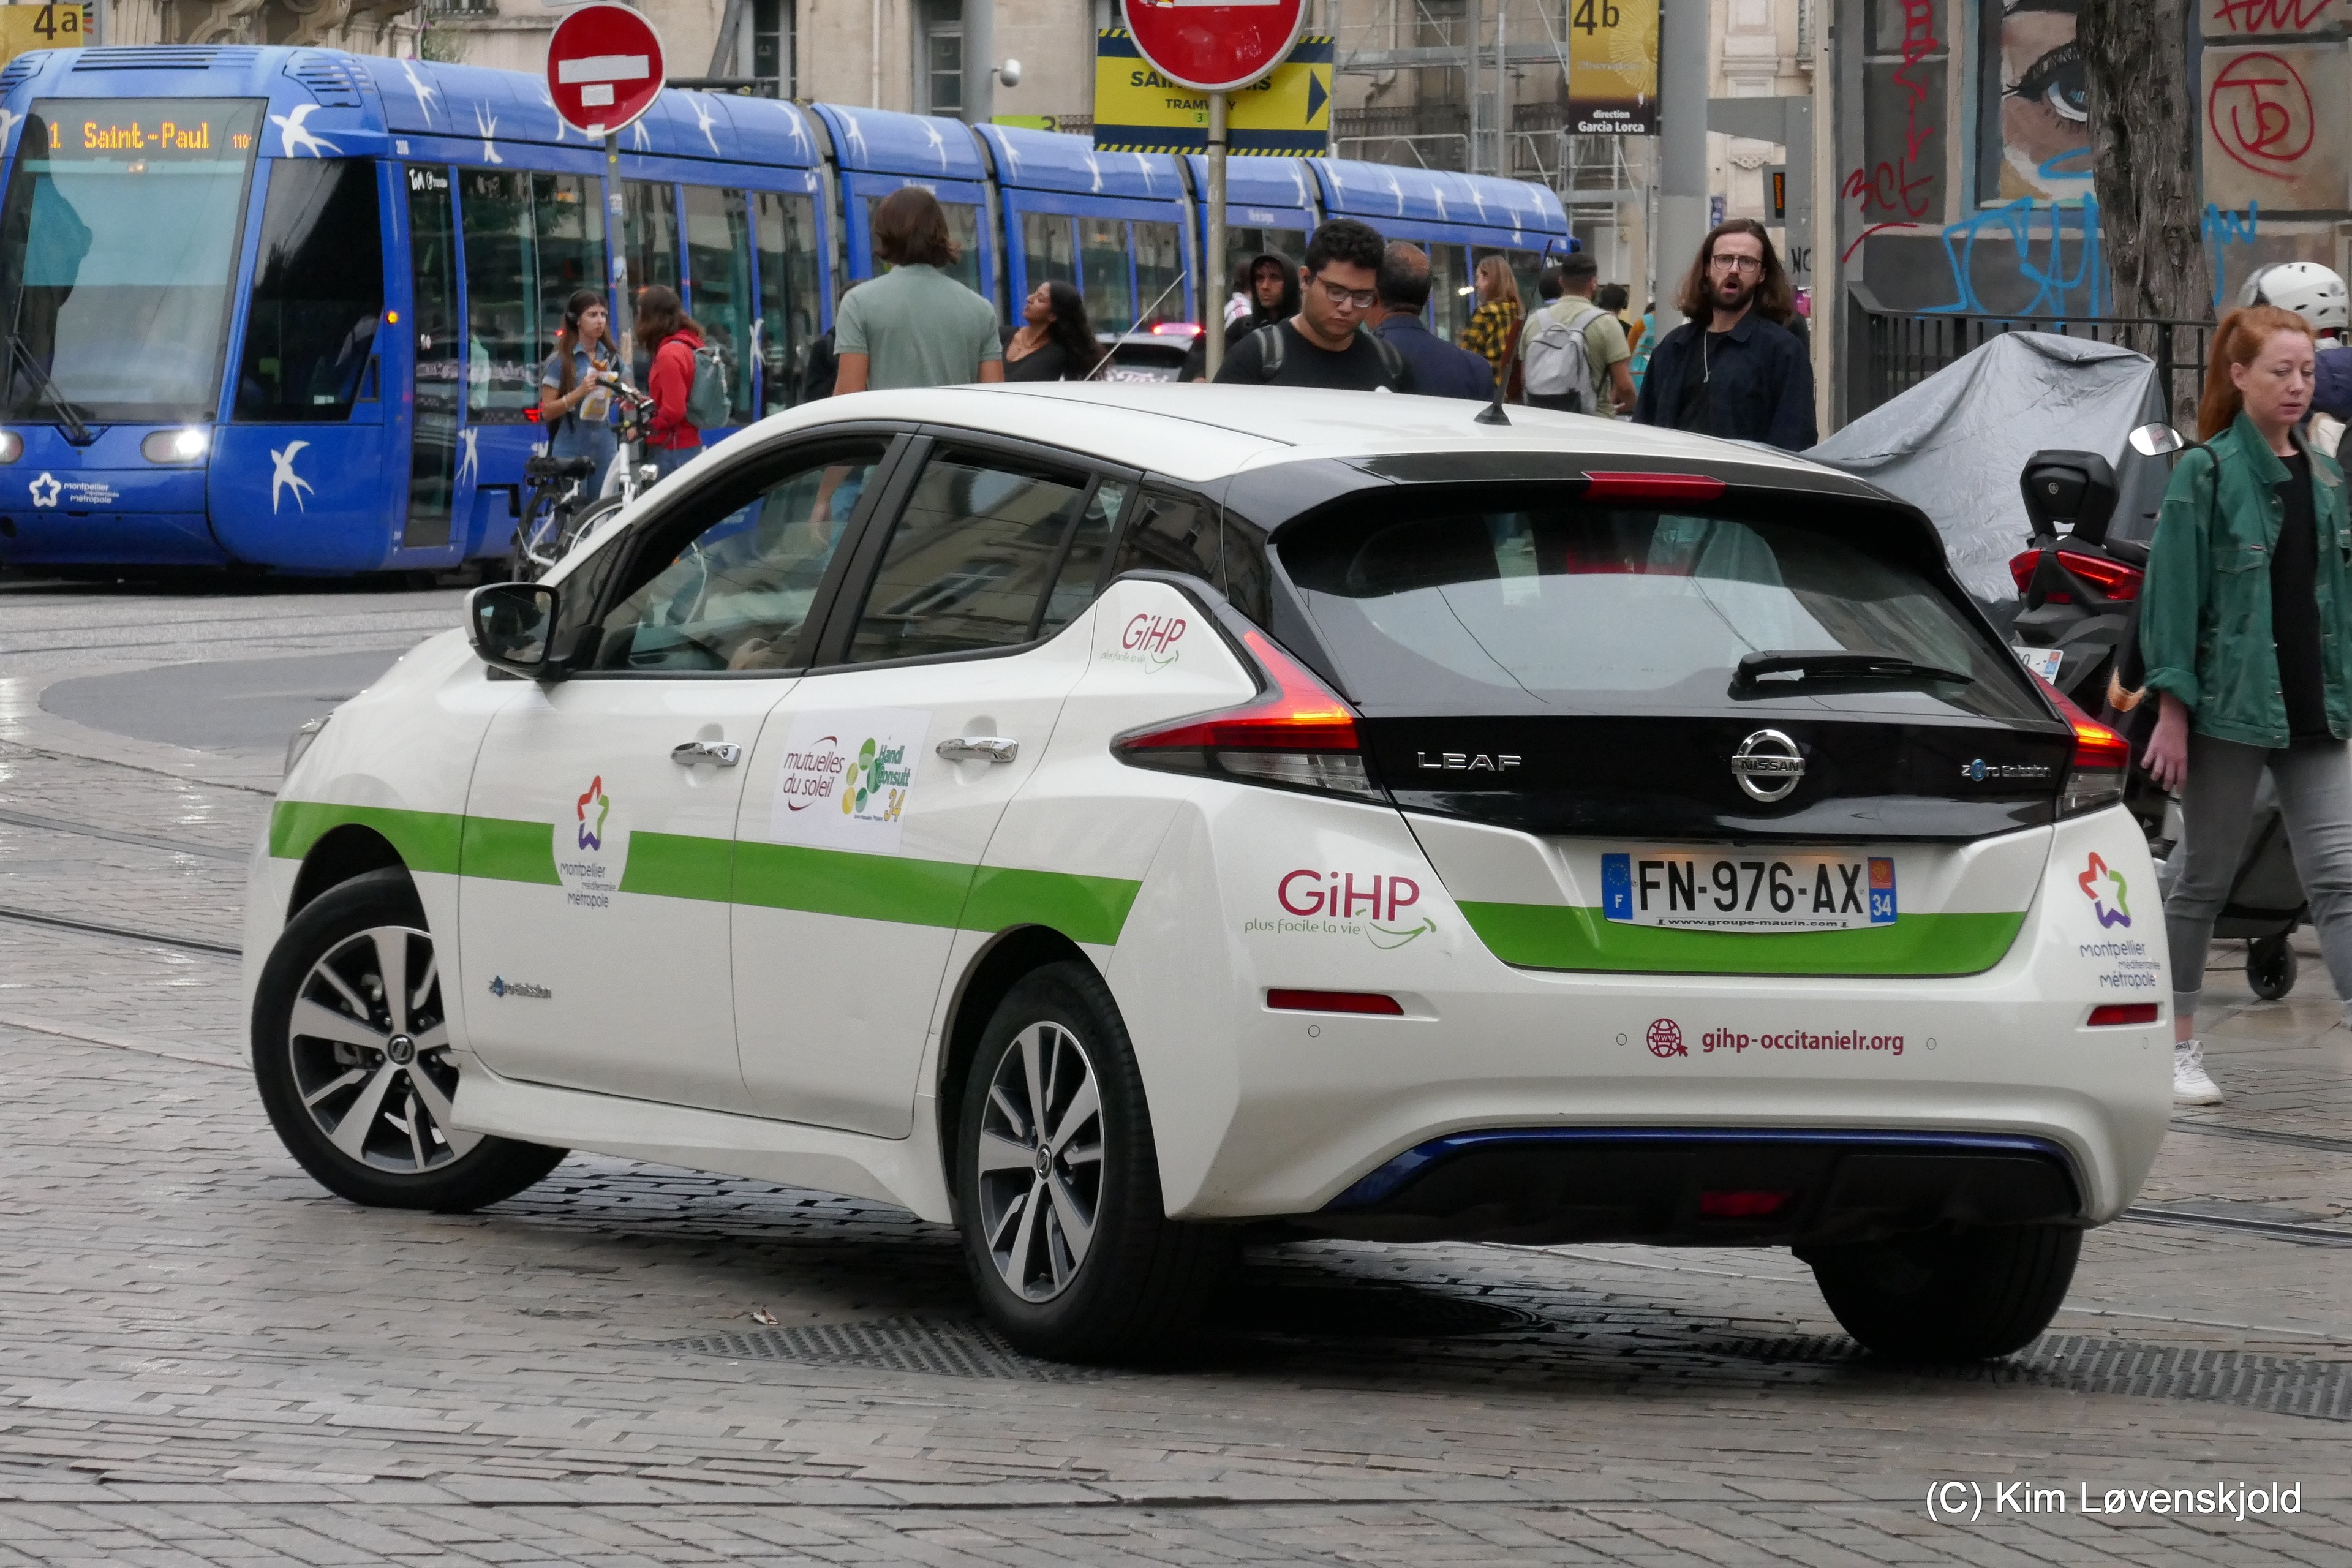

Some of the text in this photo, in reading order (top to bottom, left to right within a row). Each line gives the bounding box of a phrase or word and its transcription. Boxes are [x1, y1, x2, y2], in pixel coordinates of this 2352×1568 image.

[34, 4, 78, 40] 4a
[1573, 0, 1620, 36] 4b
[1165, 99, 1236, 111] TRAMY
[1593, 110, 1630, 119] direction
[1196, 113, 1204, 123] 3
[1578, 121, 1645, 132] Garcia Lorca
[49, 121, 61, 149] 1
[1122, 613, 1186, 654] GiHP
[783, 751, 845, 774] mutuelles
[1417, 752, 1521, 771] LEAF
[1741, 760, 1800, 772] NISSAN
[783, 773, 835, 798] du soleil
[560, 862, 606, 879] Montpellier
[1278, 869, 1420, 921] GiHP
[1638, 860, 1864, 914] FN-976-AX
[567, 891, 609, 910] Métropole
[1615, 894, 1623, 908] F
[1872, 894, 1892, 916] 34
[1245, 918, 1361, 935] plus facile la vie
[2079, 940, 2146, 959] Montpellier
[2100, 971, 2156, 989] Métropole
[1702, 1027, 1904, 1055] gihp-occitanielr.org
